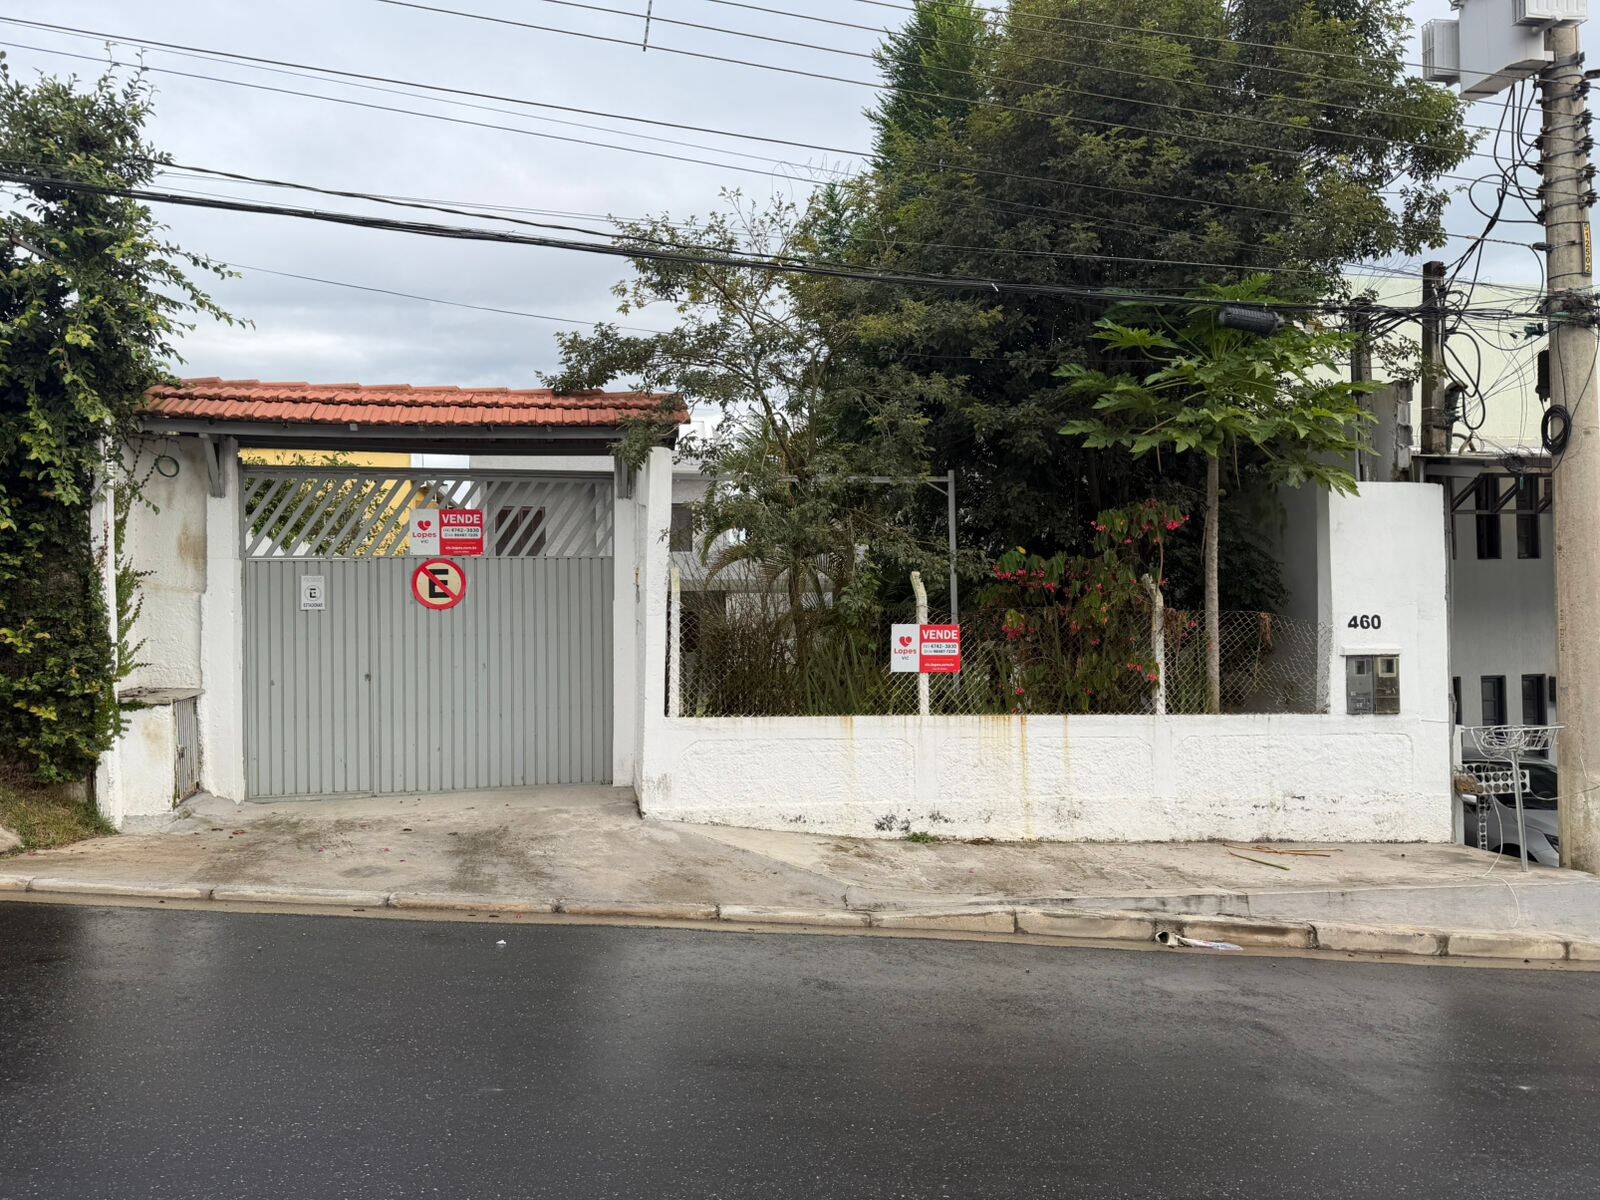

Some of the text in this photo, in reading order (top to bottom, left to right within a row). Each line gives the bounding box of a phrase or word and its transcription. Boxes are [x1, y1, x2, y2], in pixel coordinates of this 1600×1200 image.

[441, 514, 480, 524] VENDE
[1348, 614, 1381, 630] 460
[922, 629, 958, 640] VENDE
